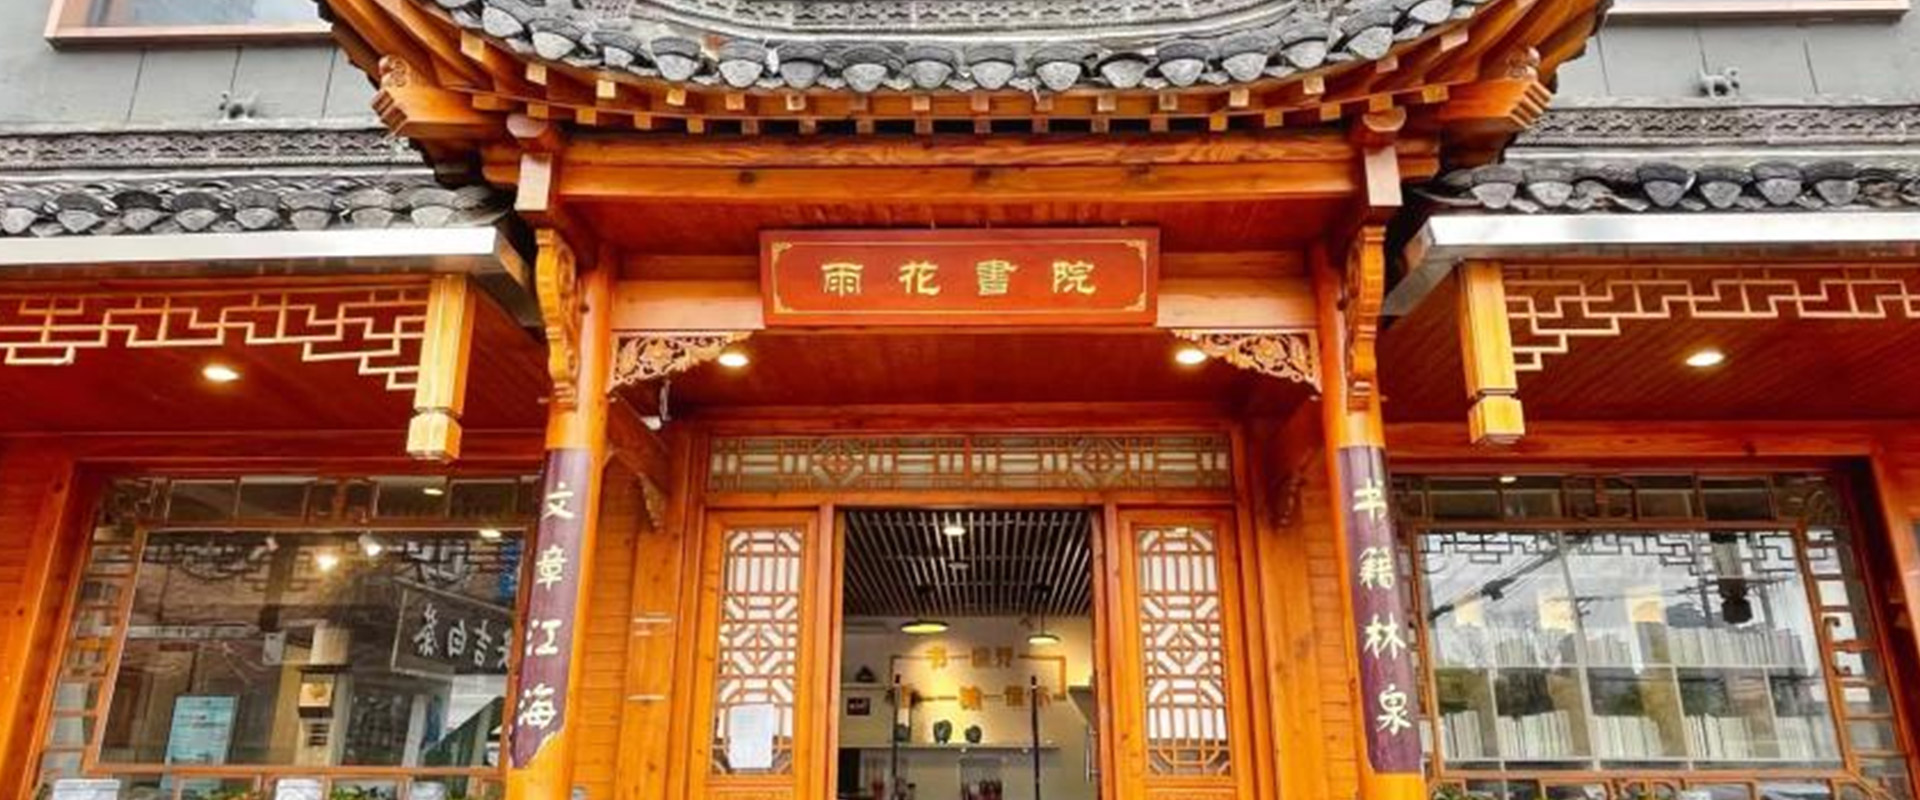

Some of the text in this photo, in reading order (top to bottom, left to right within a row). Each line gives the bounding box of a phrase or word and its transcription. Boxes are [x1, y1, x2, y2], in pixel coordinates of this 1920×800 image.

[821, 259, 1097, 297] 雨花書院
[518, 481, 575, 729] 文章江海
[1353, 477, 1412, 736] 书籍林泉
